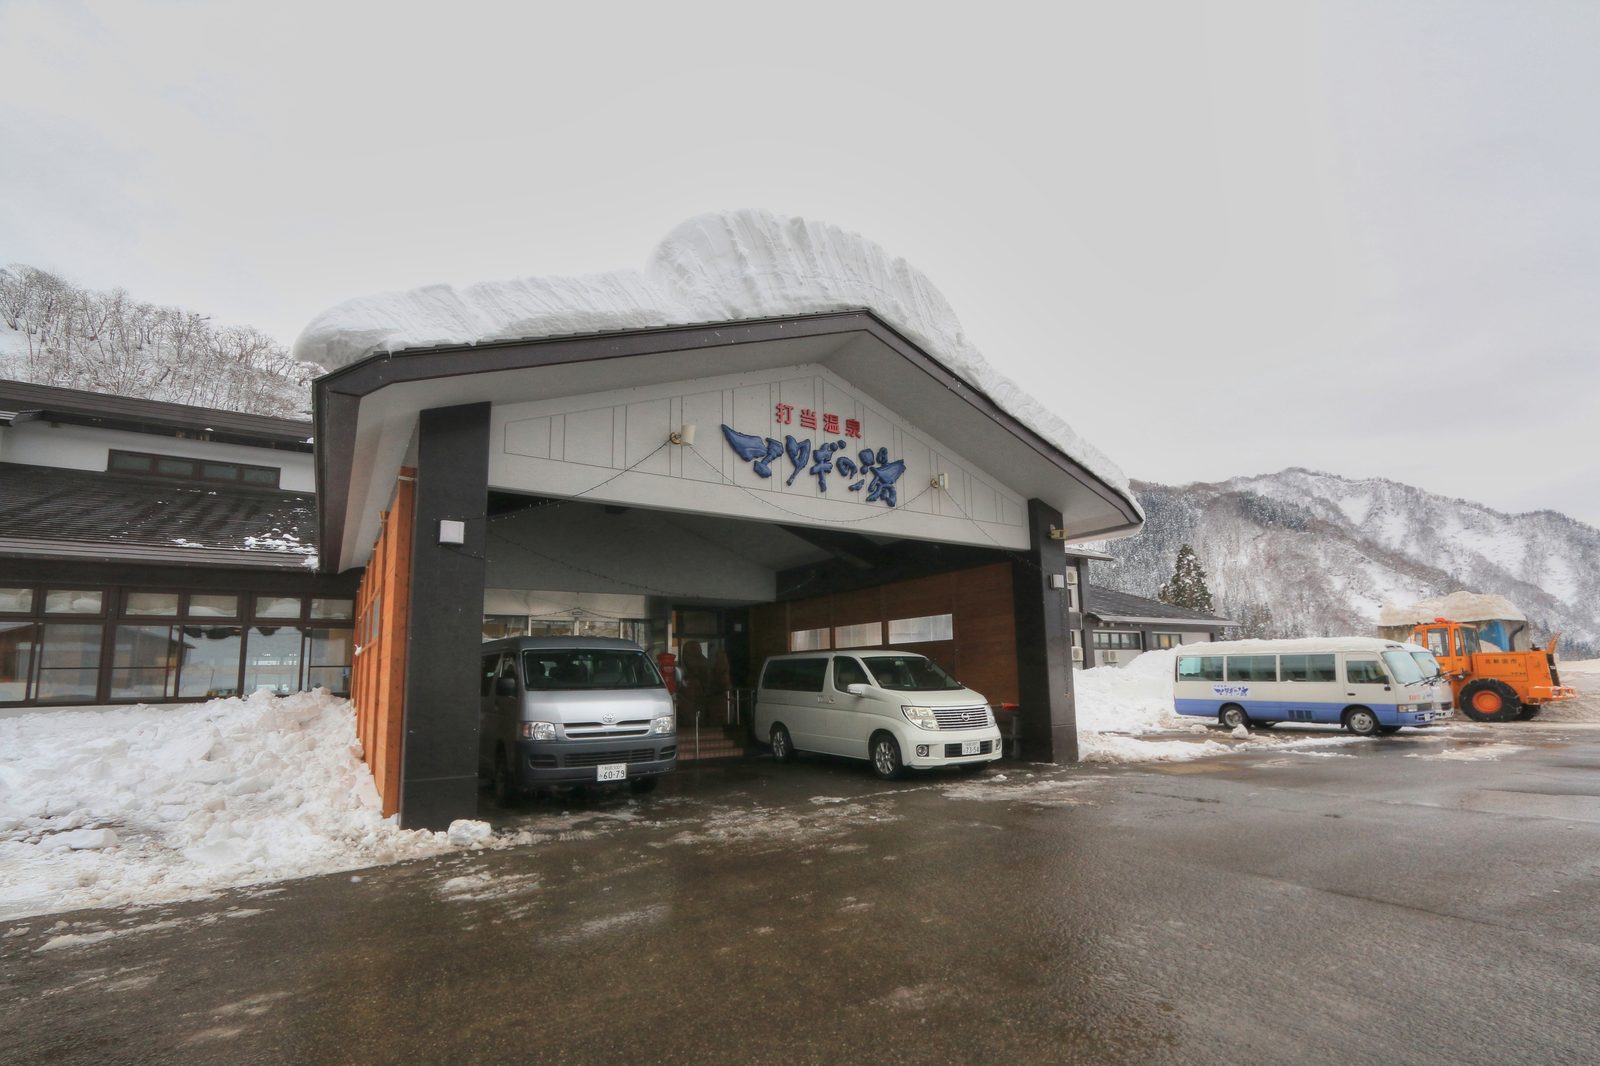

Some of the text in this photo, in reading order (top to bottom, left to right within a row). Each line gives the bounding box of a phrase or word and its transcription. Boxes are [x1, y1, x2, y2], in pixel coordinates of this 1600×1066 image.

[775, 402, 862, 439] 打当温泉
[603, 769, 625, 779] 60-79
